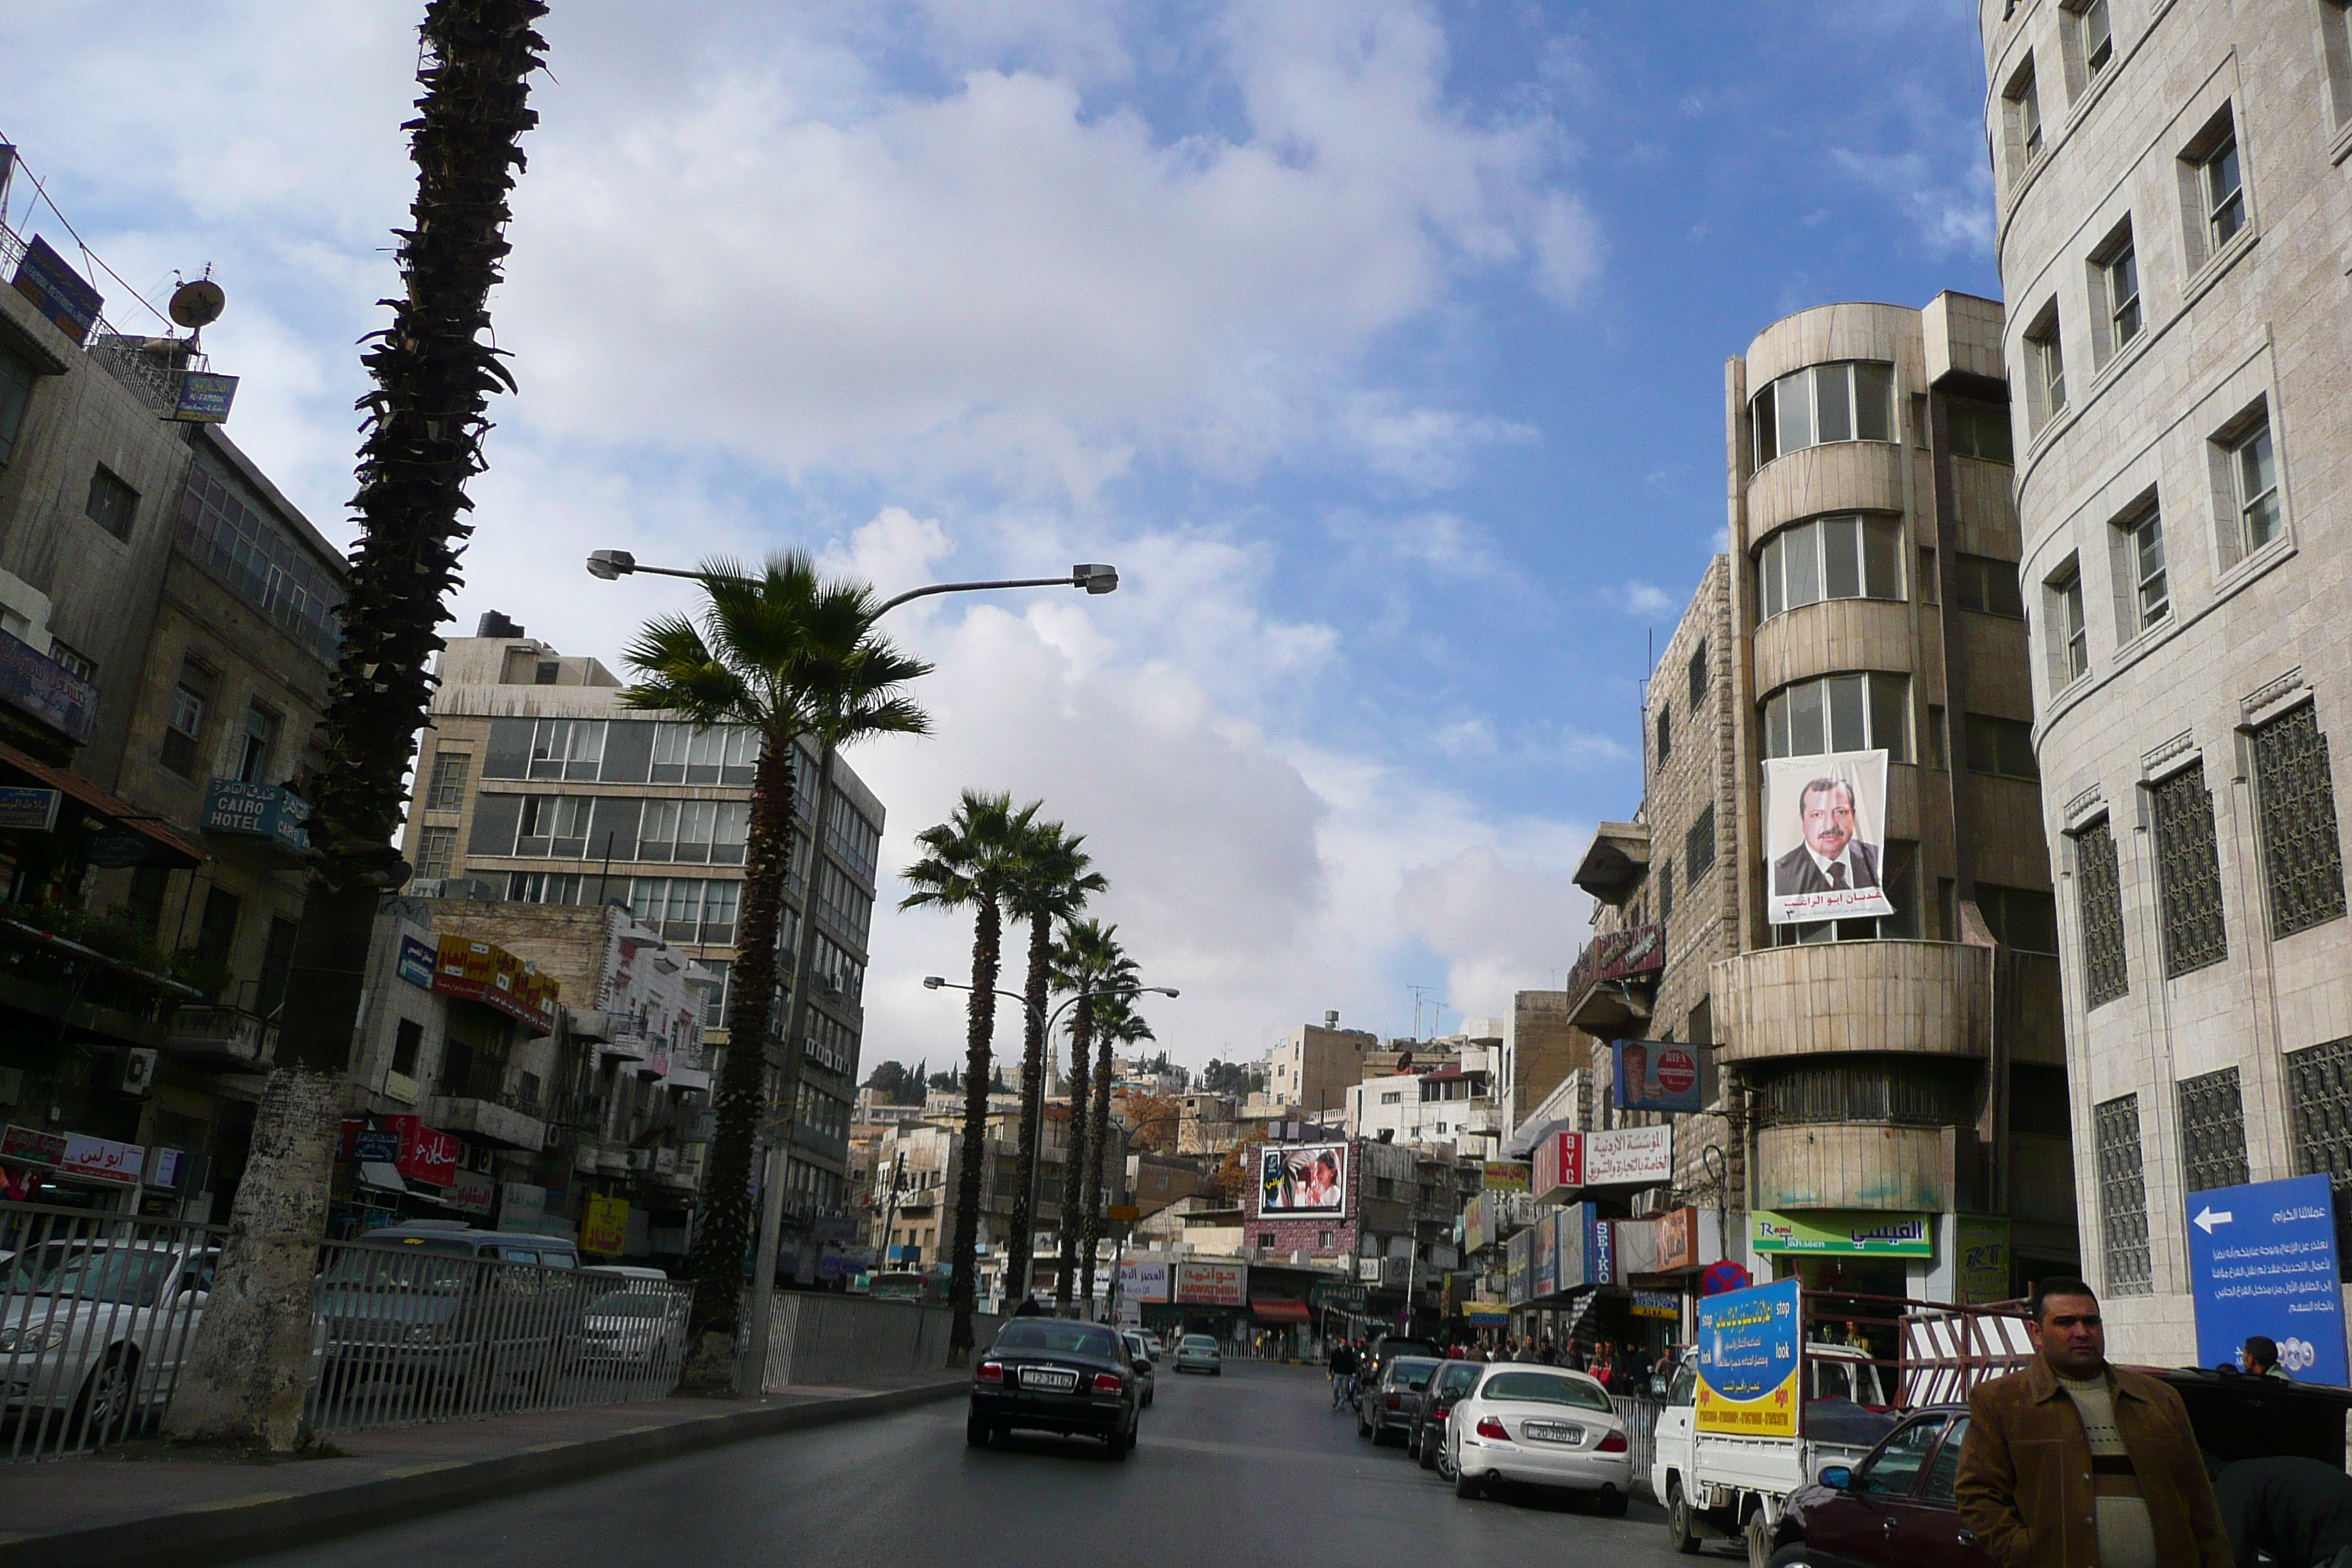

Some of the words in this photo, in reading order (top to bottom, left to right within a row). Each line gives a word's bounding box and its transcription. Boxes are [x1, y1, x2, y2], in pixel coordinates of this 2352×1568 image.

[214, 780, 246, 796] القاهرة
[246, 784, 276, 800] فندق
[218, 797, 265, 815] CAIRO
[211, 811, 263, 832] HOTEL
[277, 821, 300, 843] CAIRO
[80, 1145, 105, 1166] لبن
[105, 1145, 125, 1168] أبو
[1760, 1221, 1793, 1237] Rami
[1850, 1219, 1923, 1249] القيسي
[1779, 1234, 1825, 1248] Tahseen
[1597, 1222, 1610, 1284] SEIKO
[1181, 1284, 1238, 1295] HAWATMEH
[1635, 1298, 1675, 1310] SEIKO
[1776, 1300, 1790, 1319] stop
[1702, 1314, 1713, 1330] stop
[1700, 1349, 1711, 1365] look
[1775, 1341, 1790, 1359] look
